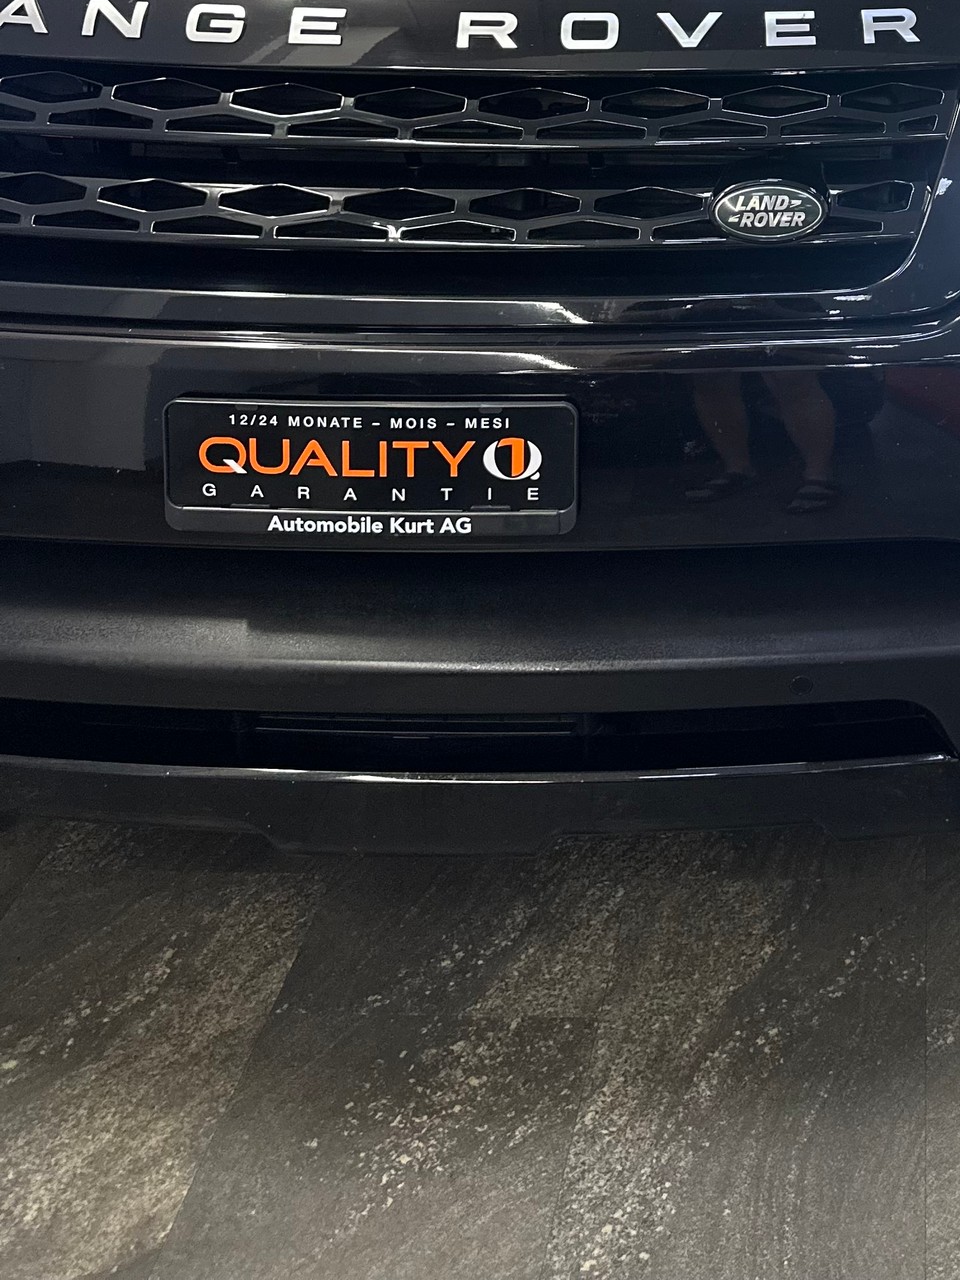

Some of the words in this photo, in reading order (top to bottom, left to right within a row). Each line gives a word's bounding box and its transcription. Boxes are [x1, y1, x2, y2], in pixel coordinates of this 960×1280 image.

[456, 8, 920, 50] ROVER
[736, 195, 790, 211] LAND
[739, 212, 806, 228] ROVER
[229, 414, 278, 427] 12/24
[288, 416, 363, 428] MONATE
[390, 417, 437, 429] MOIS
[465, 417, 510, 429] MESI
[198, 436, 476, 478] QUALITY
[202, 483, 540, 502] GARANTIE
[267, 515, 384, 534] Automobile
[389, 517, 435, 534] Kurt
[439, 517, 472, 534] AG
